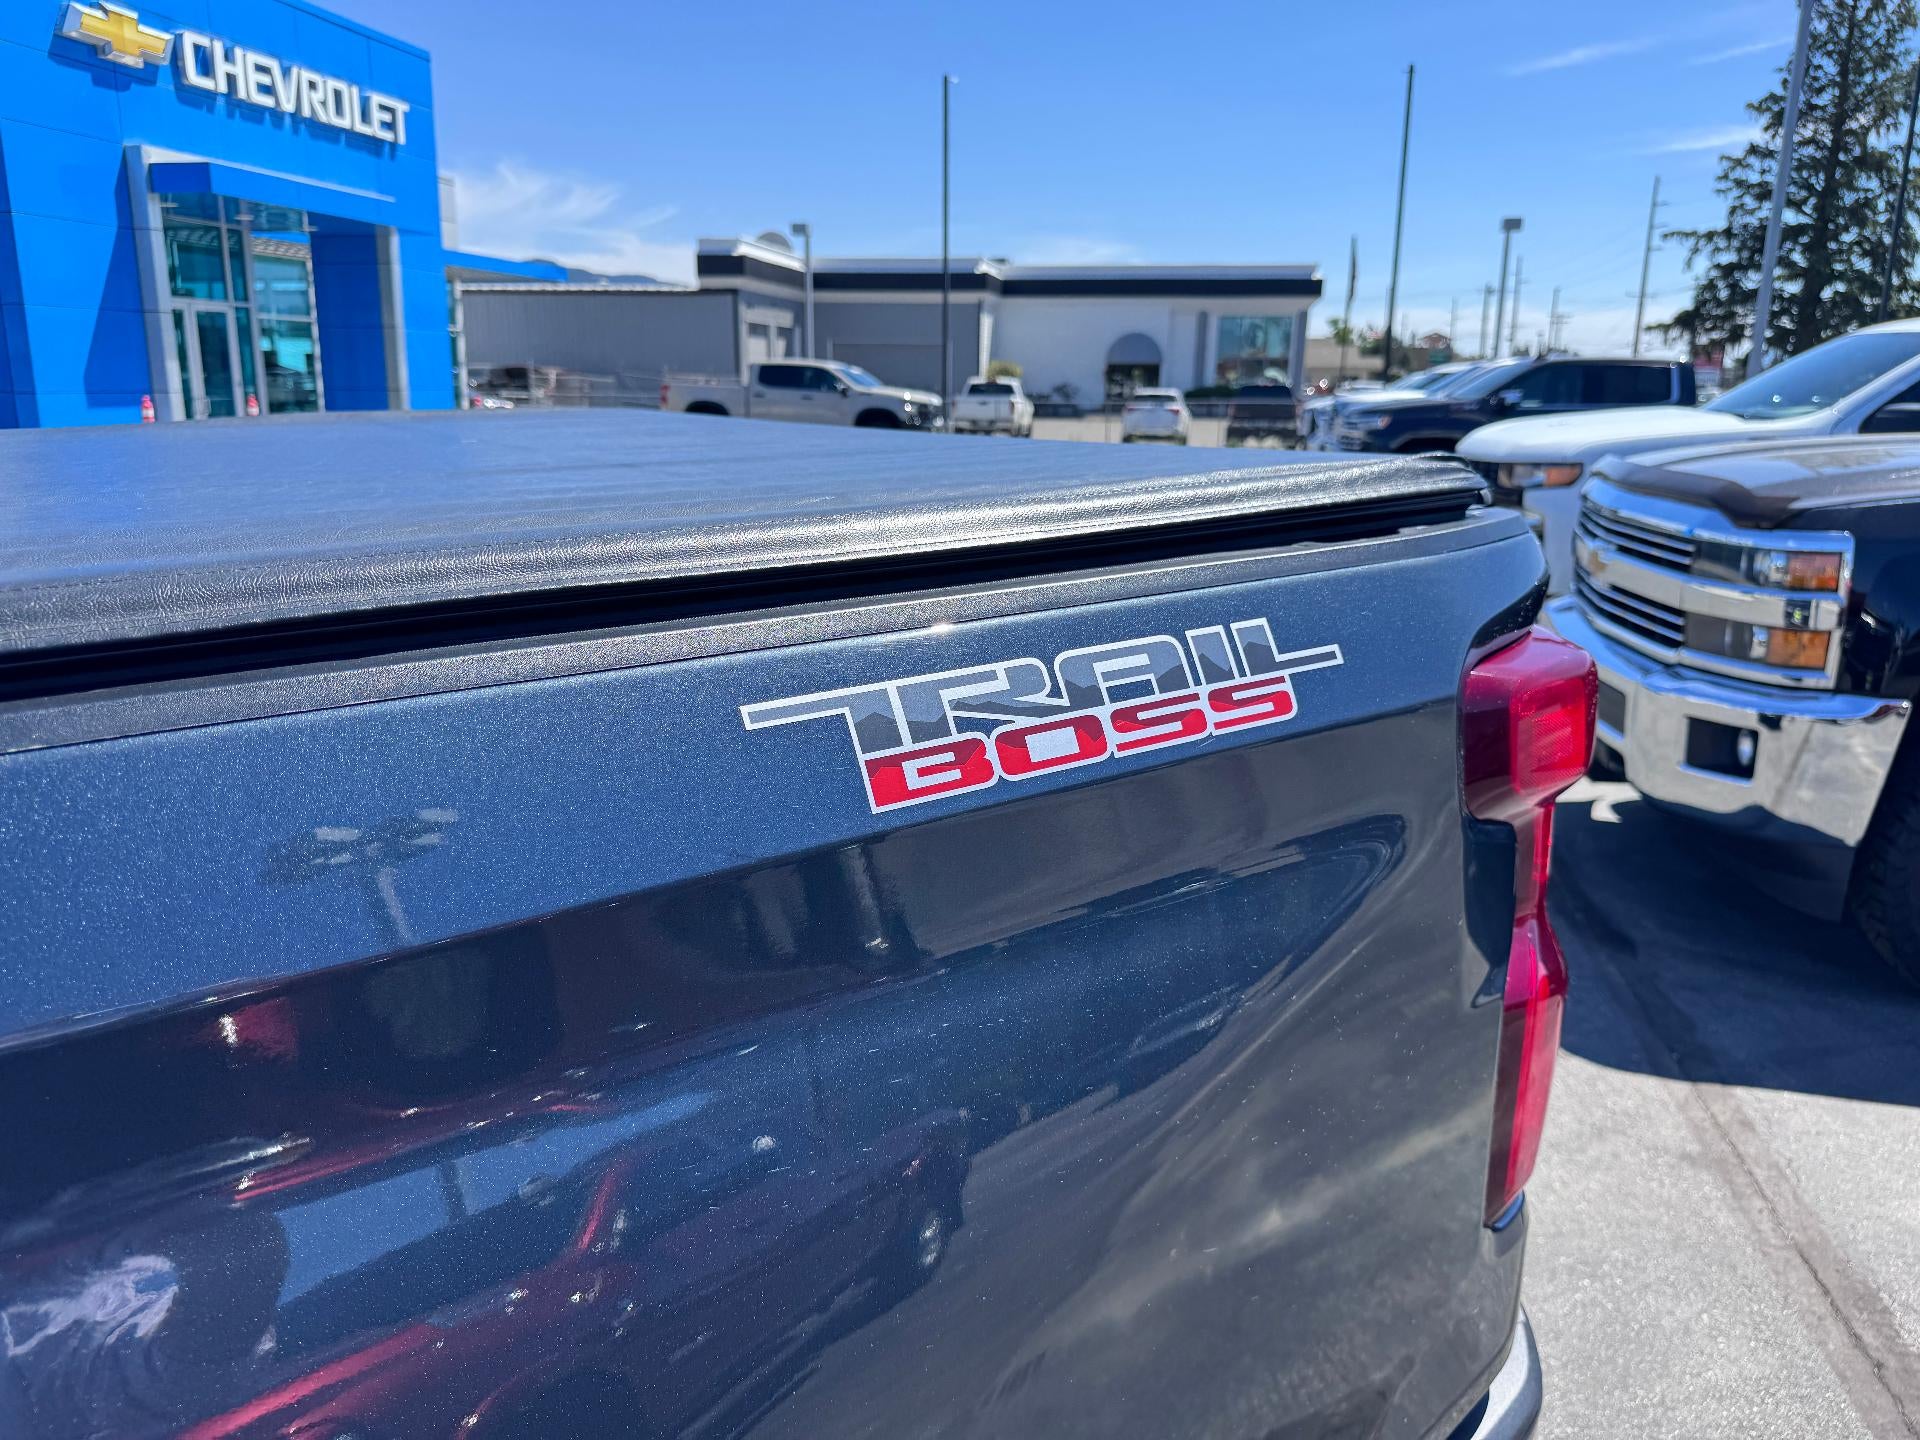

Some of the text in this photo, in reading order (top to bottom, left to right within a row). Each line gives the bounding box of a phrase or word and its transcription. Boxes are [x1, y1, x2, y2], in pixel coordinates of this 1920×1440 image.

[180, 31, 409, 145] CHEVROLET
[740, 617, 1344, 752] TRAIL
[862, 675, 1297, 814] BOSS
